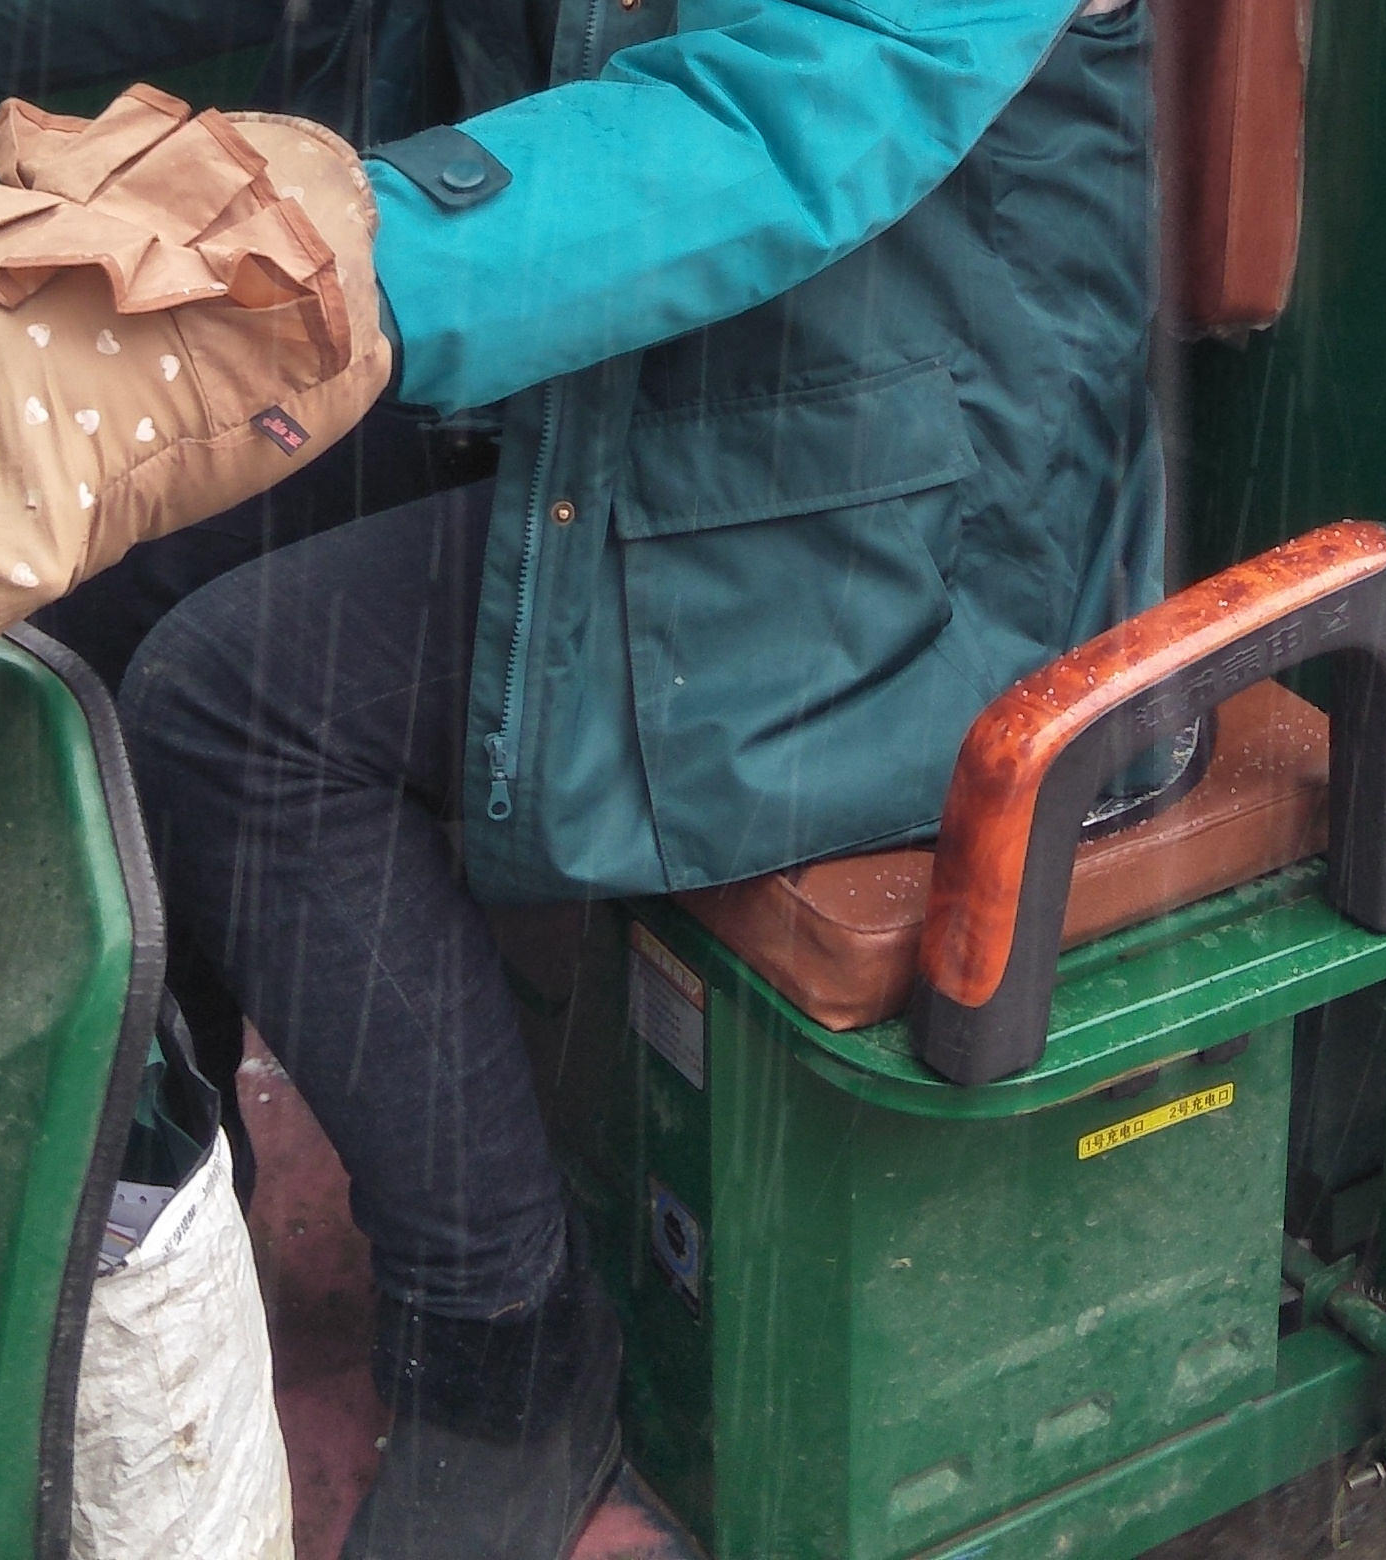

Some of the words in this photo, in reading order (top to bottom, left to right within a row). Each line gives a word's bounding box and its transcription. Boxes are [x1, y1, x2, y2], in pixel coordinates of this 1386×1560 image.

[1086, 1119, 1144, 1151] 1号充电口
[1169, 1089, 1229, 1119] 2号充电口
